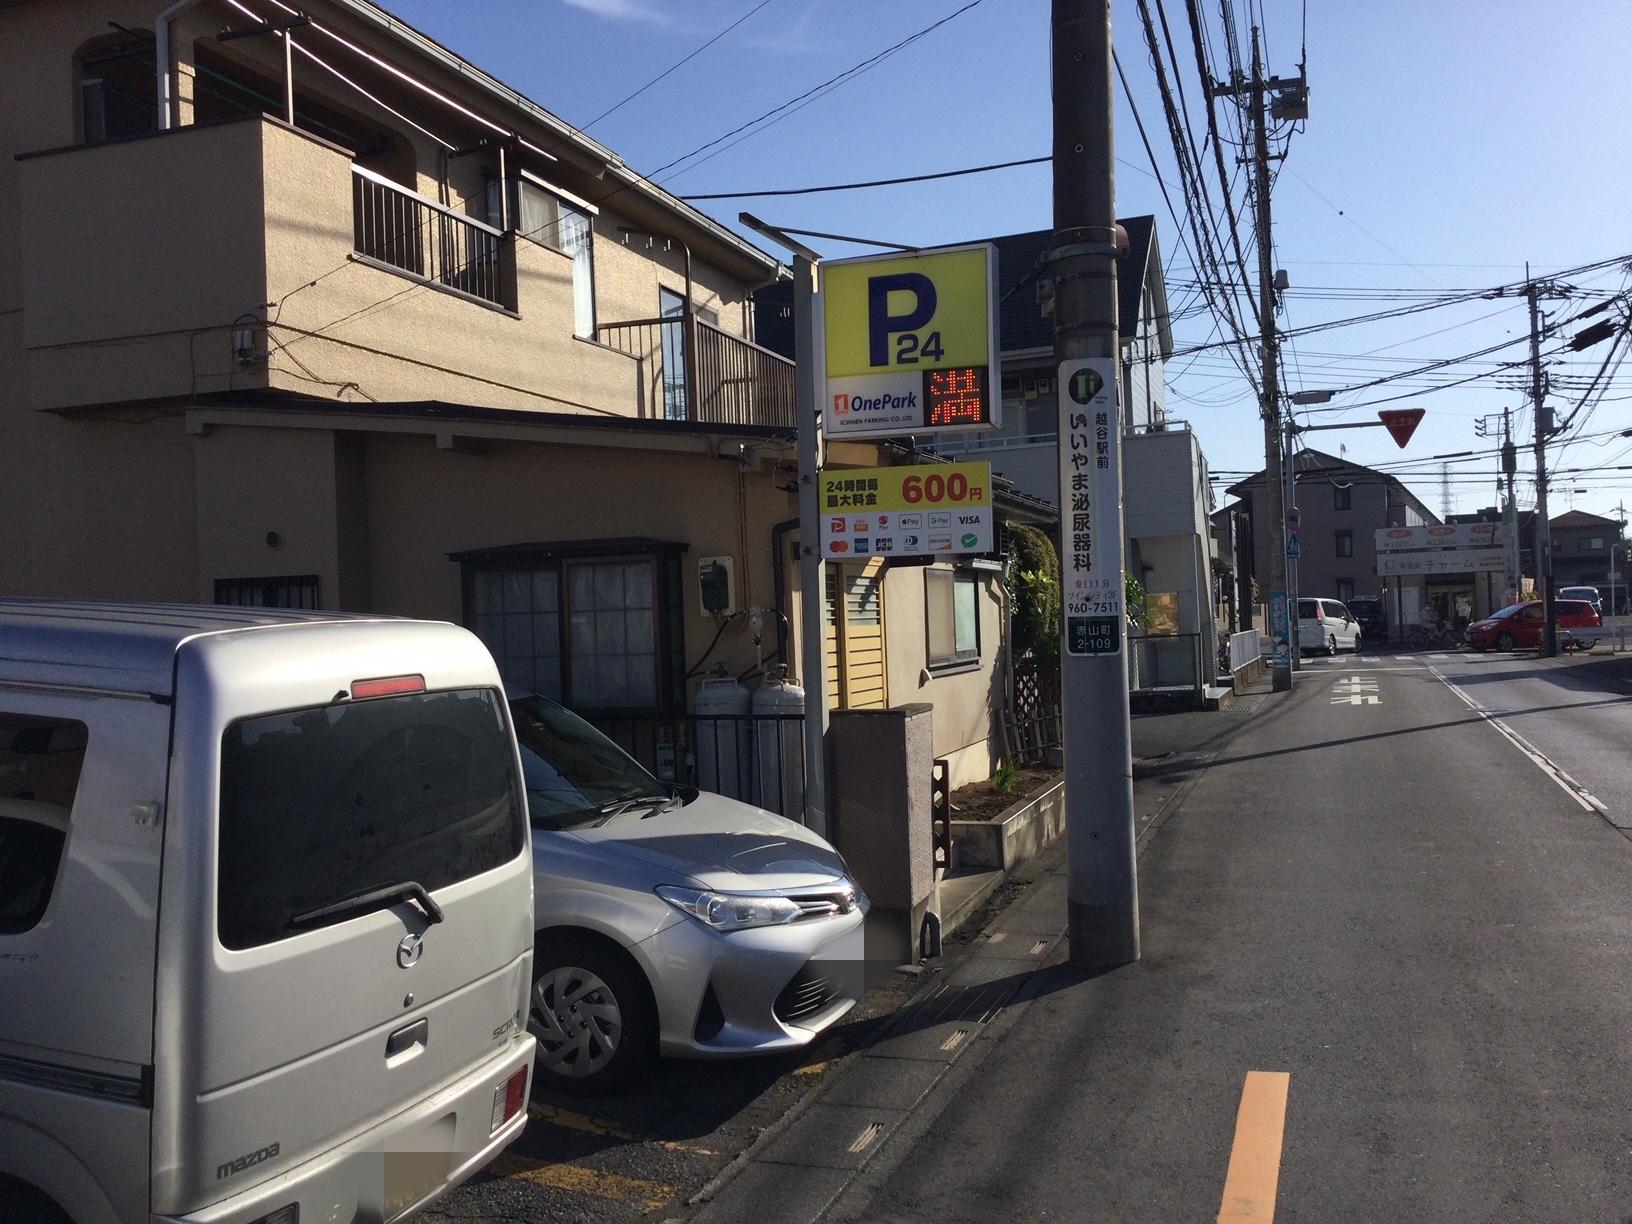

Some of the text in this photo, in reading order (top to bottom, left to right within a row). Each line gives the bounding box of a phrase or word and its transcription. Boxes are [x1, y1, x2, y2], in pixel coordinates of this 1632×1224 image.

[868, 272, 938, 367] P
[896, 331, 945, 364] 24
[851, 391, 917, 412] OnePark
[864, 416, 890, 424] PARKING
[1095, 412, 1109, 470] 越谷駅前
[902, 472, 982, 504] 600 円
[1070, 412, 1092, 573] いいやま泌尿器科
[827, 493, 878, 508] 最大料金
[907, 518, 919, 526] Pay
[959, 515, 980, 525] VISA
[1068, 602, 1118, 613] 960-7511
[1076, 625, 1111, 636] 赤山町
[1077, 638, 1111, 649] 2-109
